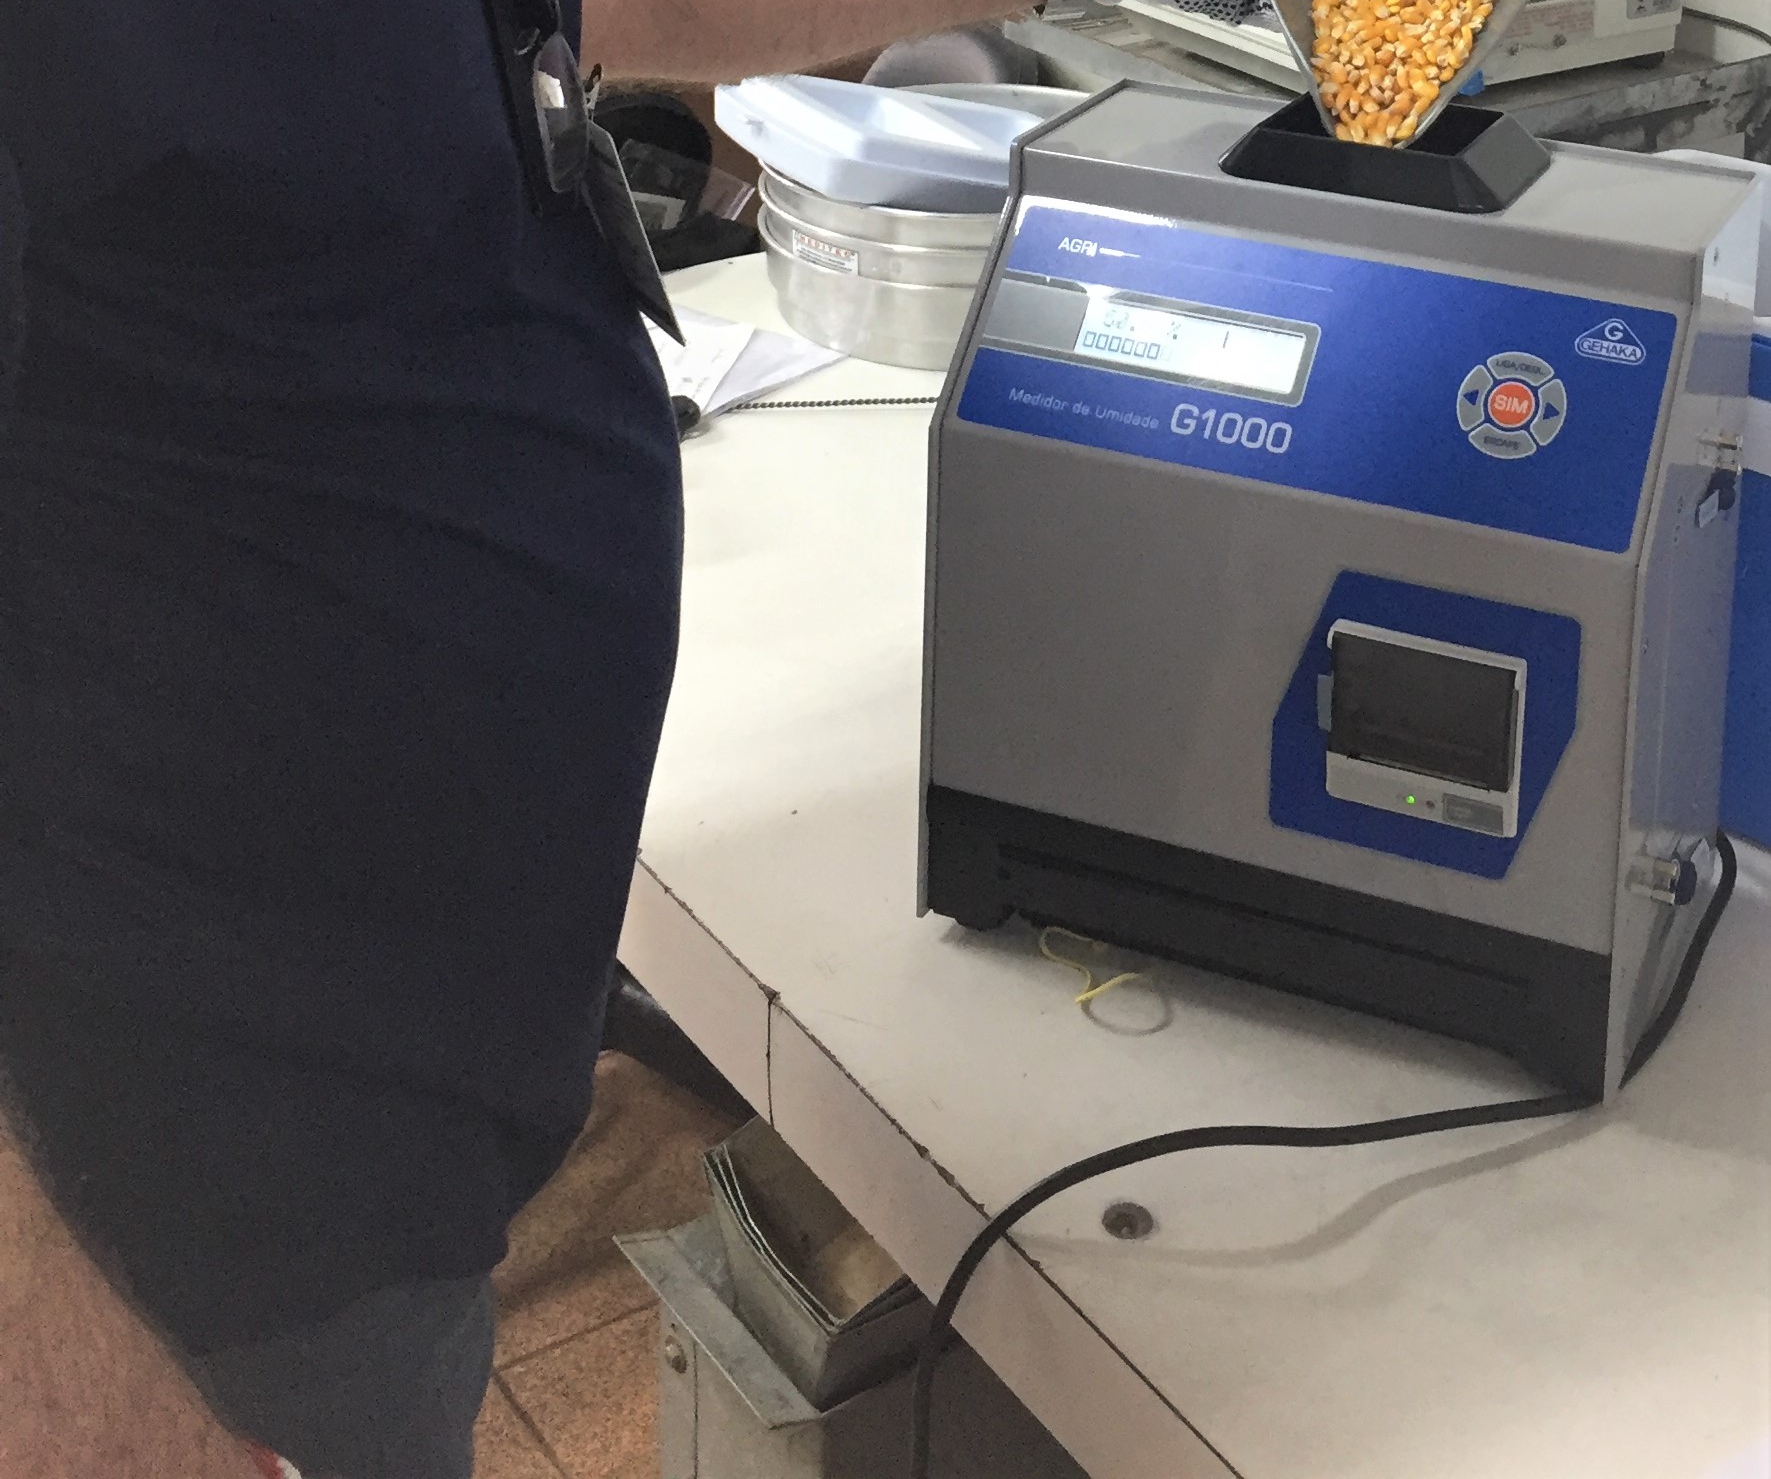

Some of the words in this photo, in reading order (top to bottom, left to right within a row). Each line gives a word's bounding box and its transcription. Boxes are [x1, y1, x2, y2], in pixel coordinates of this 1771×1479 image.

[1604, 322, 1624, 340] G
[1580, 338, 1639, 360] GEHAKA
[1493, 394, 1530, 415] SIM
[1008, 387, 1068, 411] Medidor
[1072, 401, 1090, 416] de
[1094, 405, 1160, 429] Umidade
[1170, 403, 1293, 454] G1000
